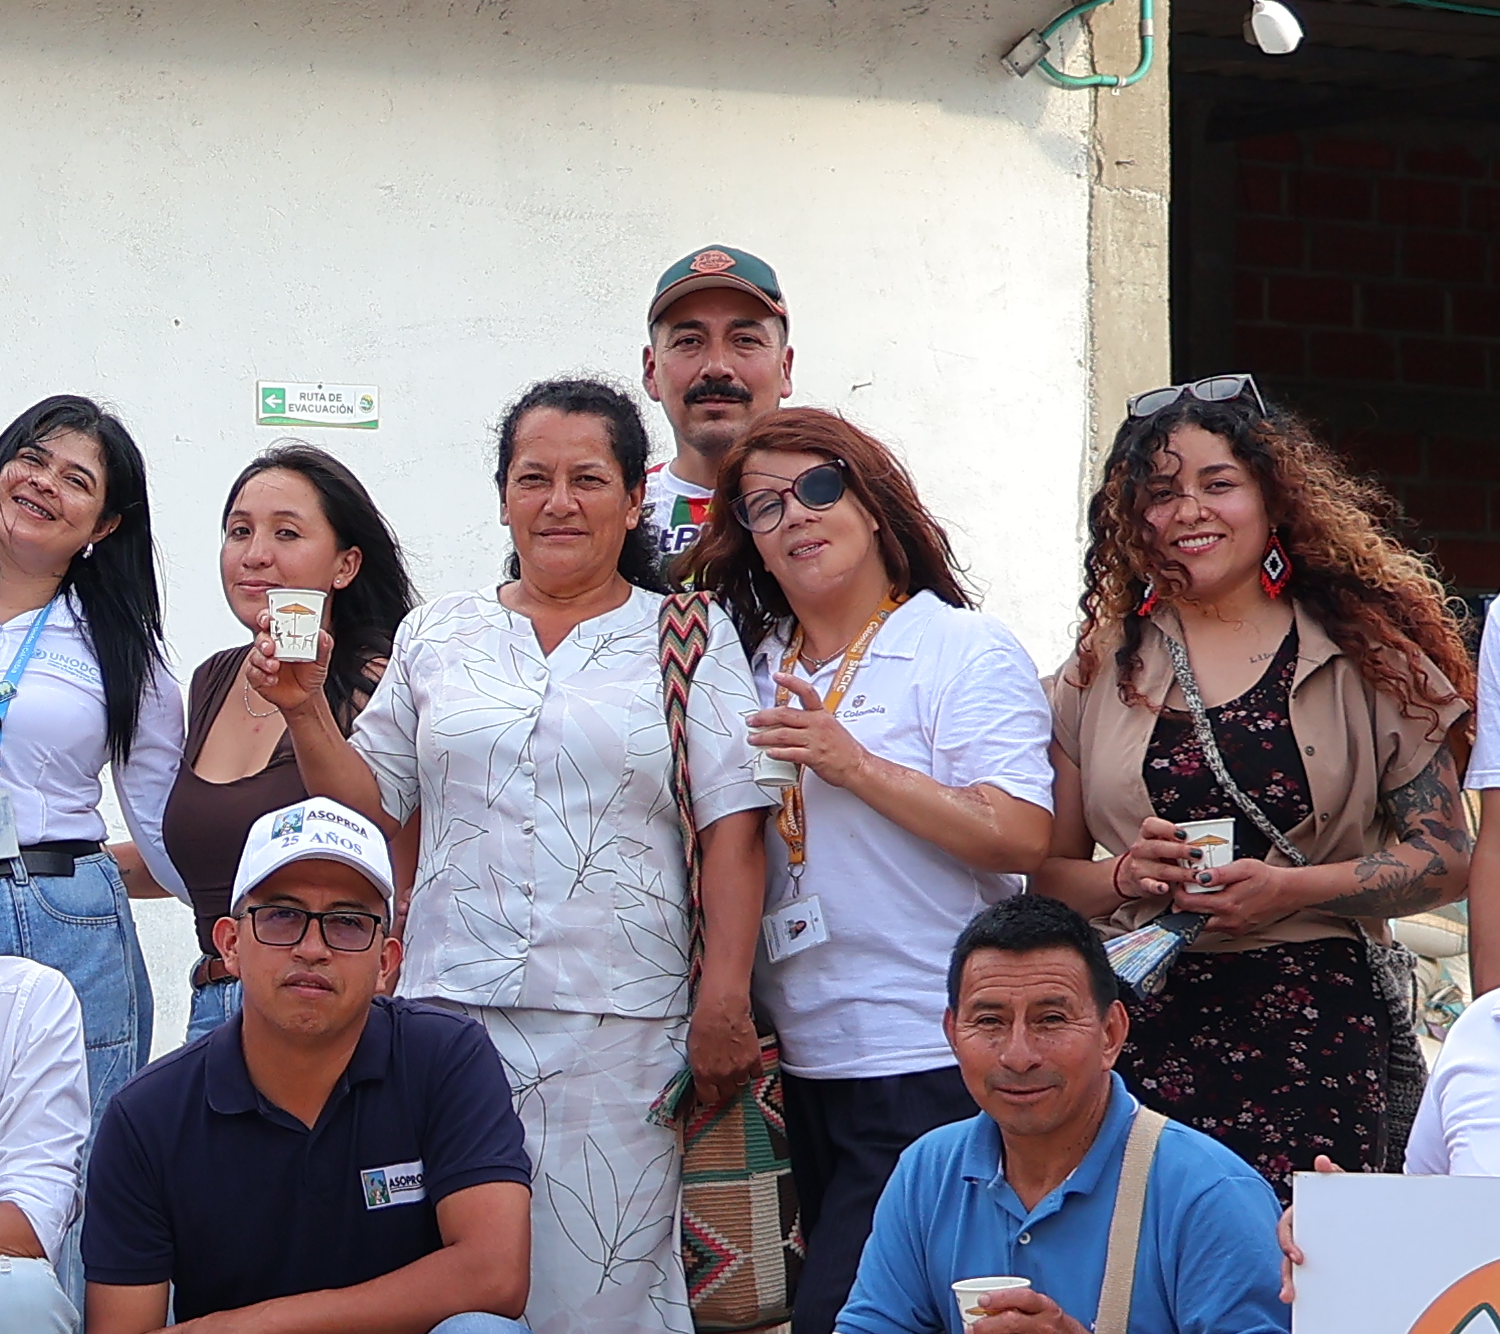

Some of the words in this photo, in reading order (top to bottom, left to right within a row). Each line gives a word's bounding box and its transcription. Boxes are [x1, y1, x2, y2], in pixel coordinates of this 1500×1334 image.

[288, 402, 354, 415] EVACUACIÓN
[300, 392, 326, 402] RUTA
[329, 393, 342, 402] DE
[851, 621, 879, 653] Colombia
[50, 652, 99, 676] UNODC
[837, 660, 859, 692] SNCIC
[306, 810, 369, 839] ASOPROA
[281, 835, 300, 848] 25
[309, 831, 362, 855] AÑOS
[389, 1173, 424, 1187] ASOPRO
